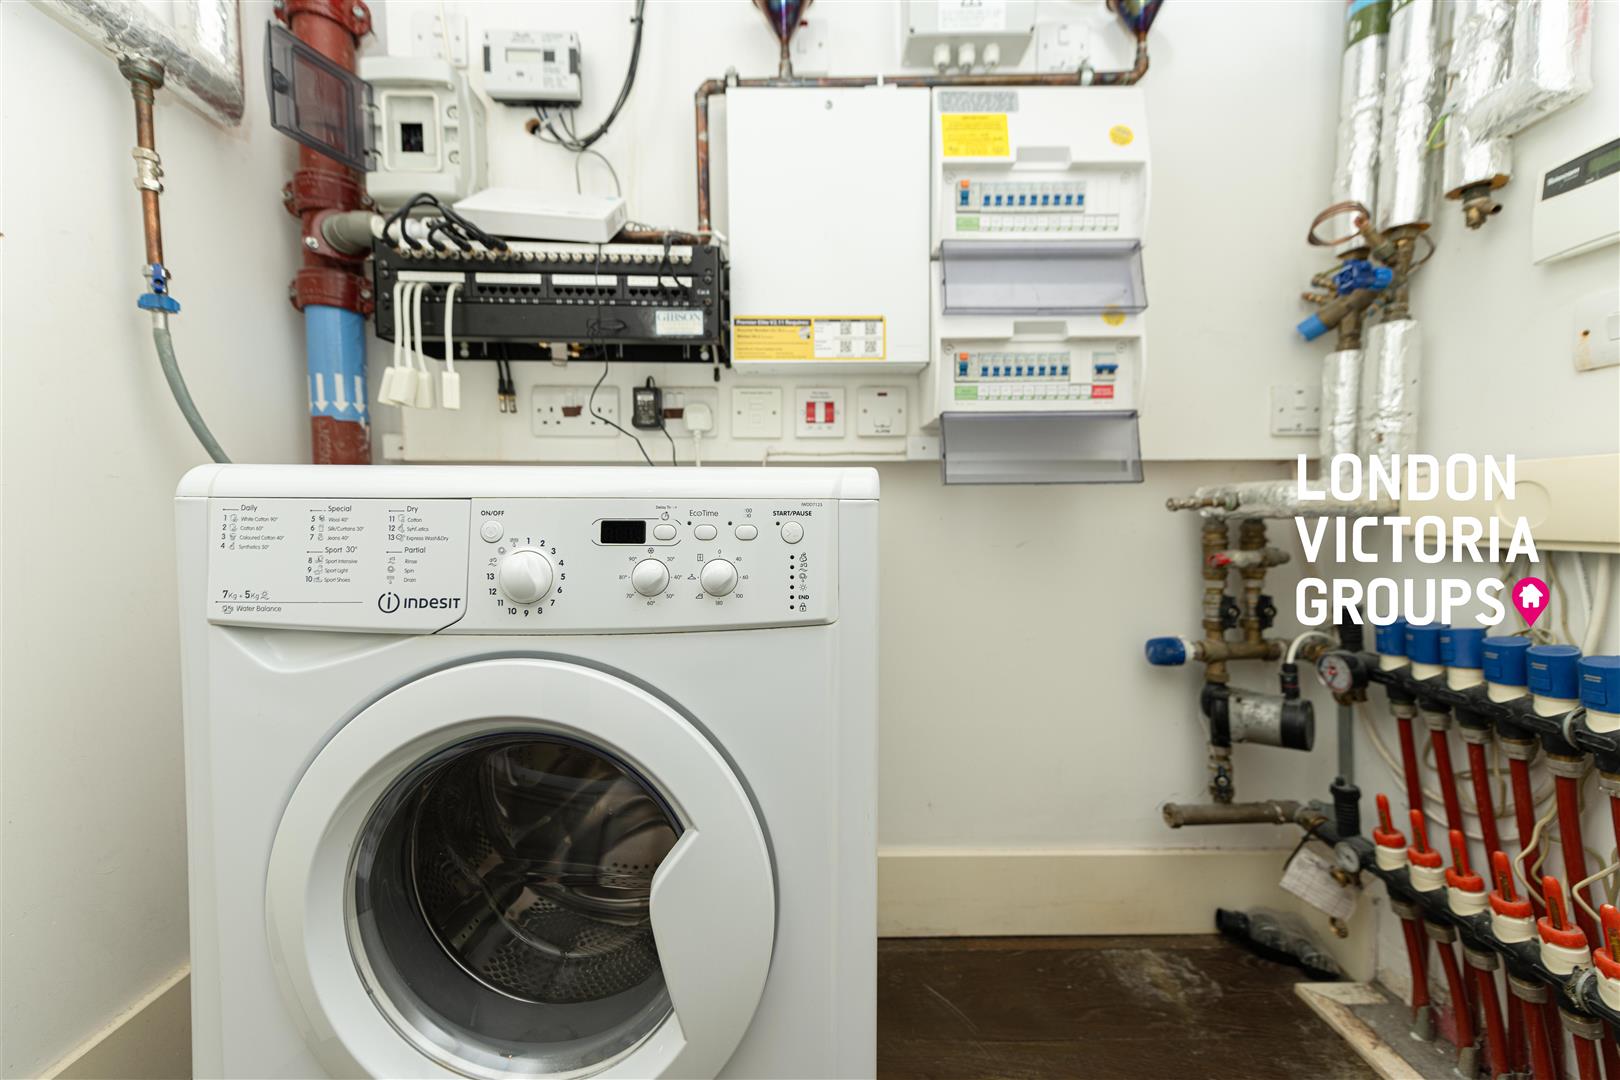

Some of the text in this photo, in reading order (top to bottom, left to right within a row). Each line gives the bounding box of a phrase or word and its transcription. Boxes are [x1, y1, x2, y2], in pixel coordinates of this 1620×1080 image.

[657, 312, 701, 321] GIBSON
[241, 504, 258, 512] Daily
[328, 505, 352, 513] Special
[406, 505, 419, 514] Dry
[311, 515, 316, 523] 5
[309, 533, 315, 541] 7
[388, 533, 395, 541] 13
[325, 546, 343, 554] Sport
[551, 547, 556, 555] 3
[557, 586, 563, 594] 6
[507, 607, 517, 615] 10
[524, 609, 529, 617] 9
